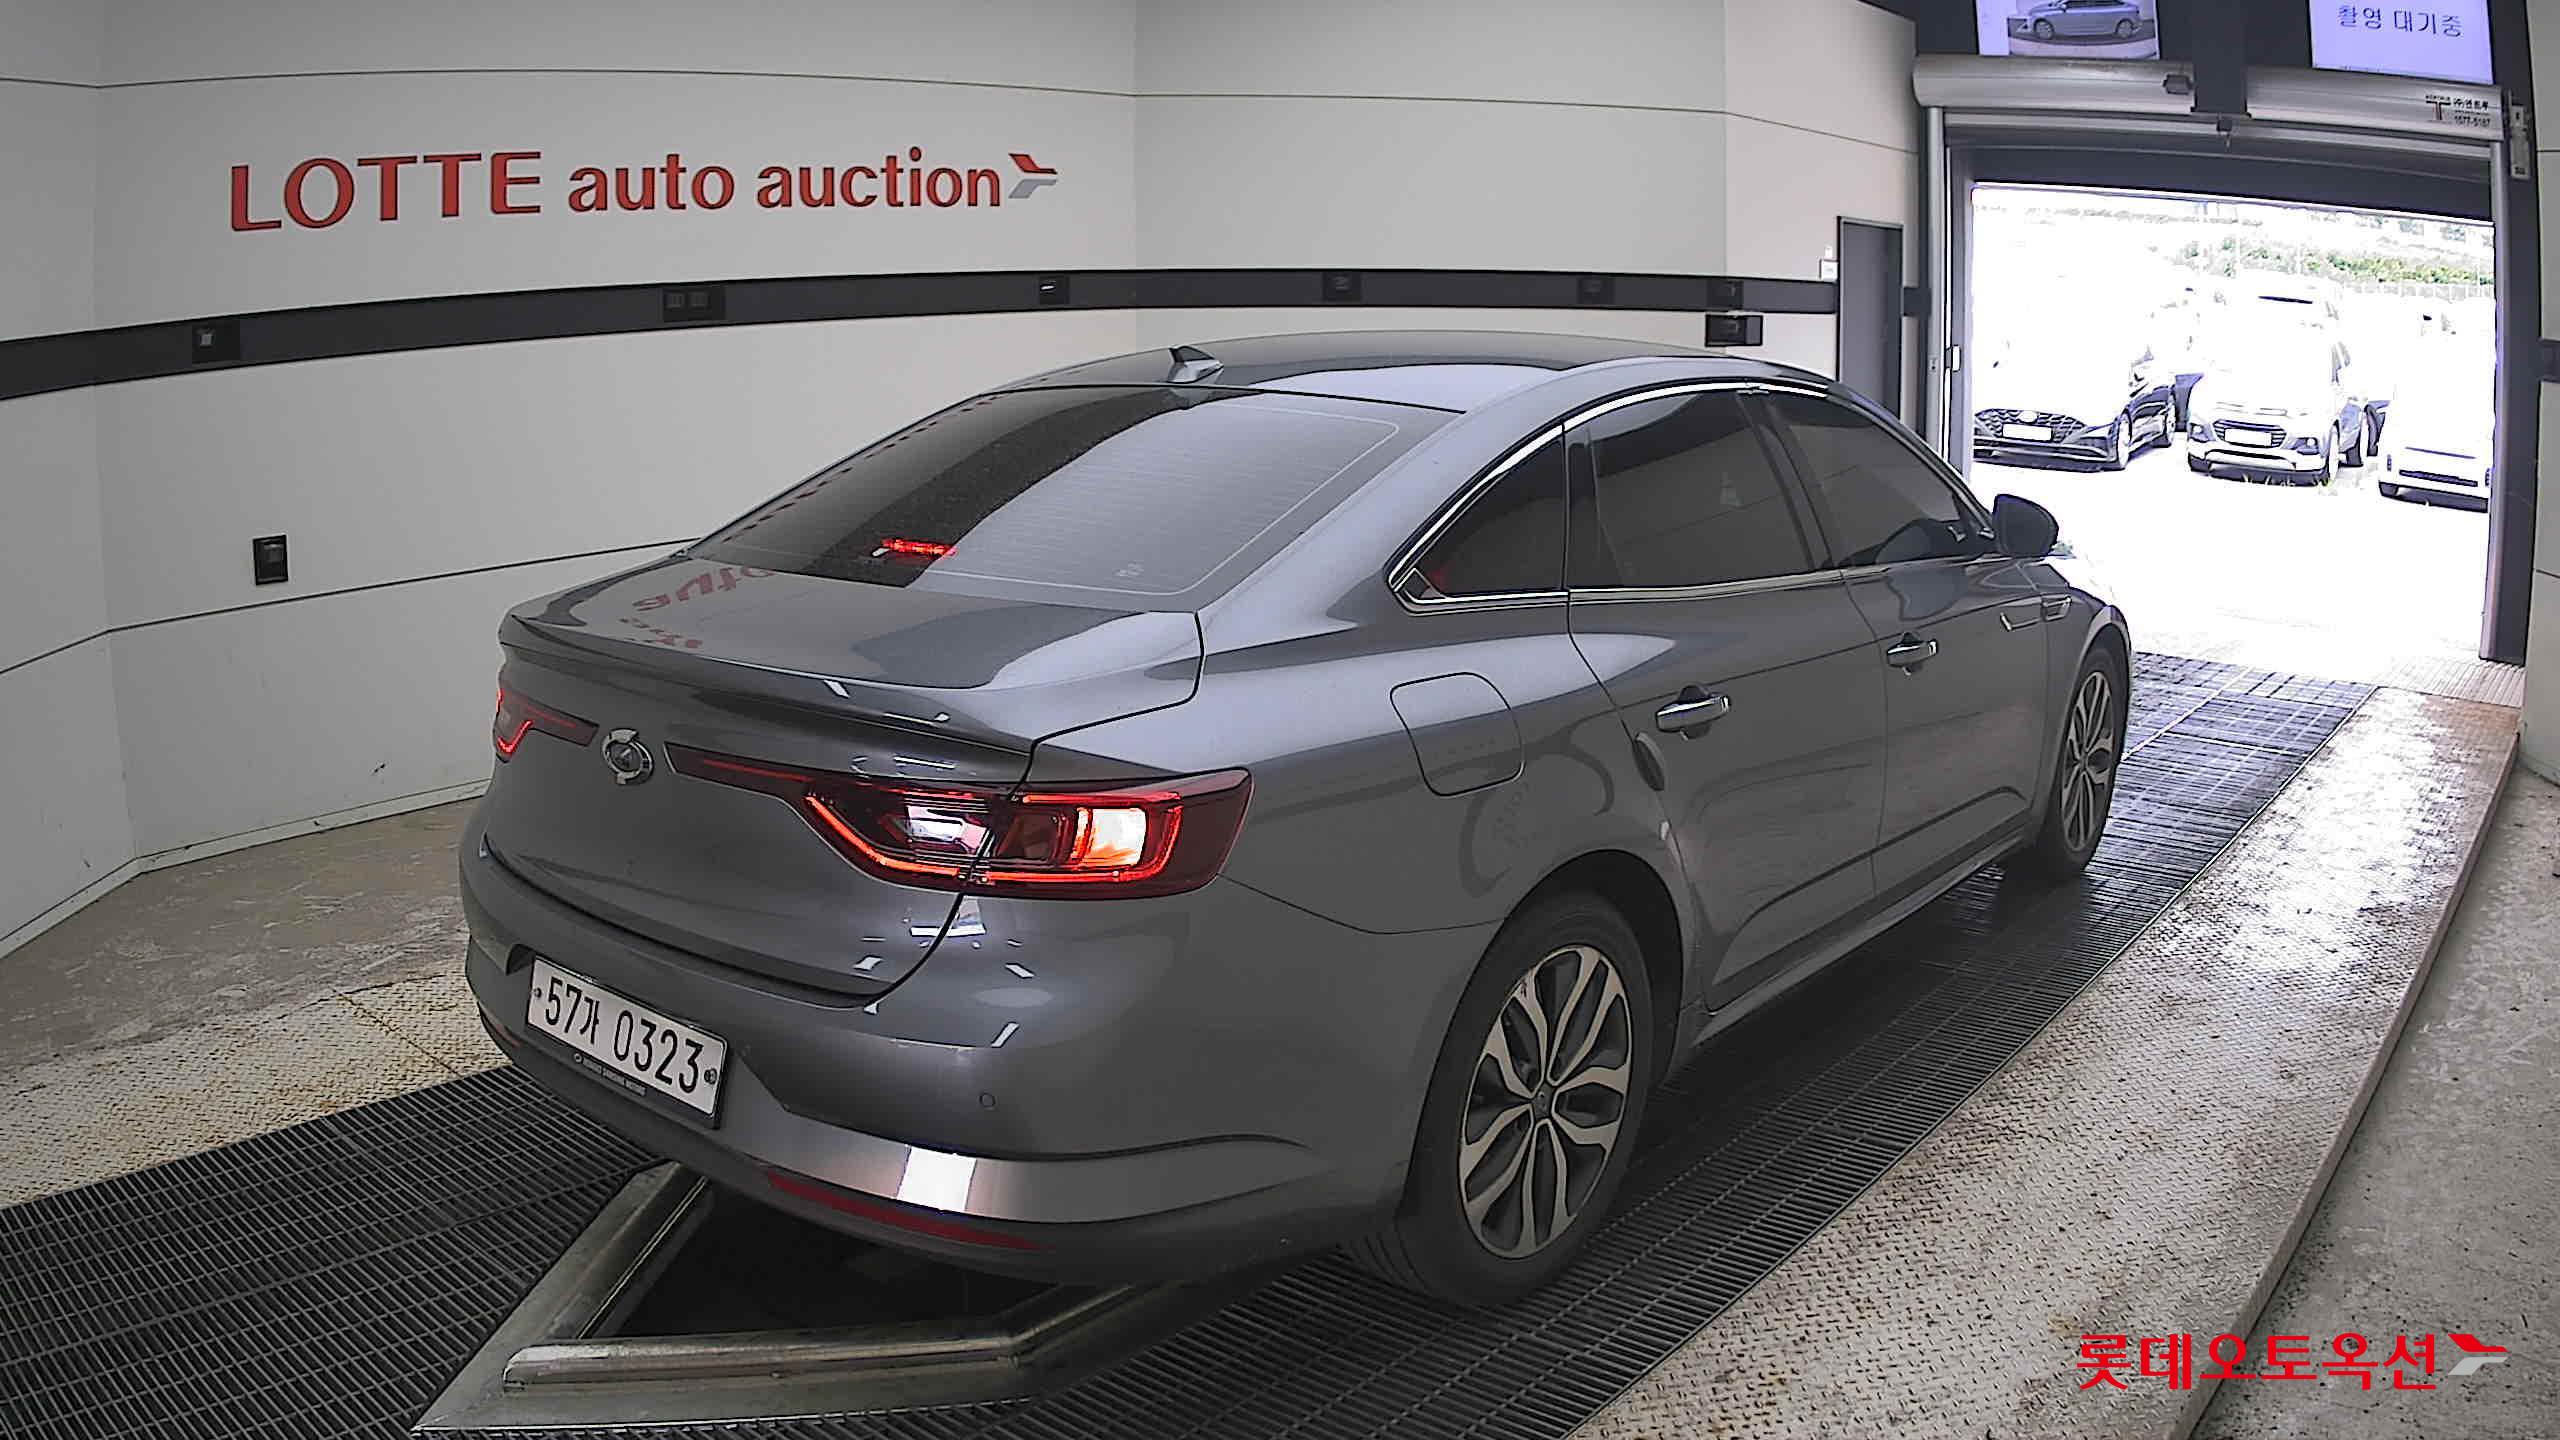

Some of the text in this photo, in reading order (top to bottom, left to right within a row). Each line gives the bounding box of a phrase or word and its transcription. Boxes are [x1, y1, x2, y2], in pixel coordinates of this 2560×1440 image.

[2338, 5, 2462, 38] 촬영 대기중
[231, 147, 1001, 231] LOTTE auto auction
[545, 976, 600, 1045] 57가
[613, 1010, 704, 1094] 0323
